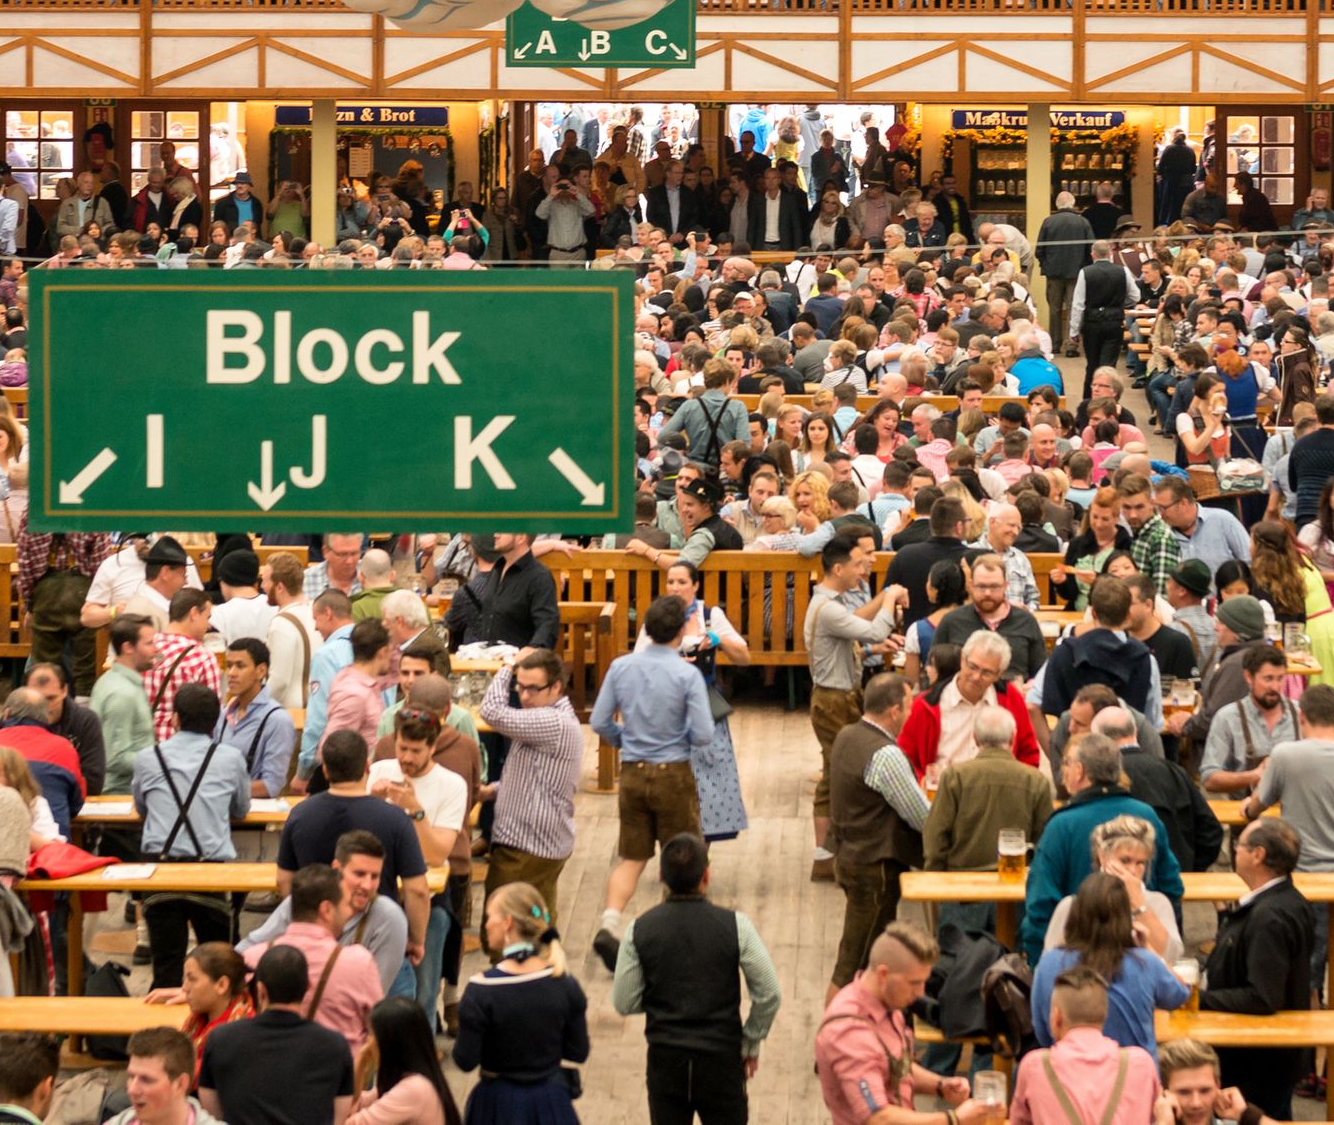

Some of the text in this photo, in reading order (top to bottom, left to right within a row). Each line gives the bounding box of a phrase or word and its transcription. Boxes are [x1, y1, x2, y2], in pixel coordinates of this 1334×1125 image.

[535, 29, 668, 55] A B C
[360, 107, 374, 122] &
[380, 107, 416, 122] Brot
[965, 111, 1113, 127] Maßkru Verkauf
[207, 309, 462, 385] Block
[146, 414, 517, 490] I J K
